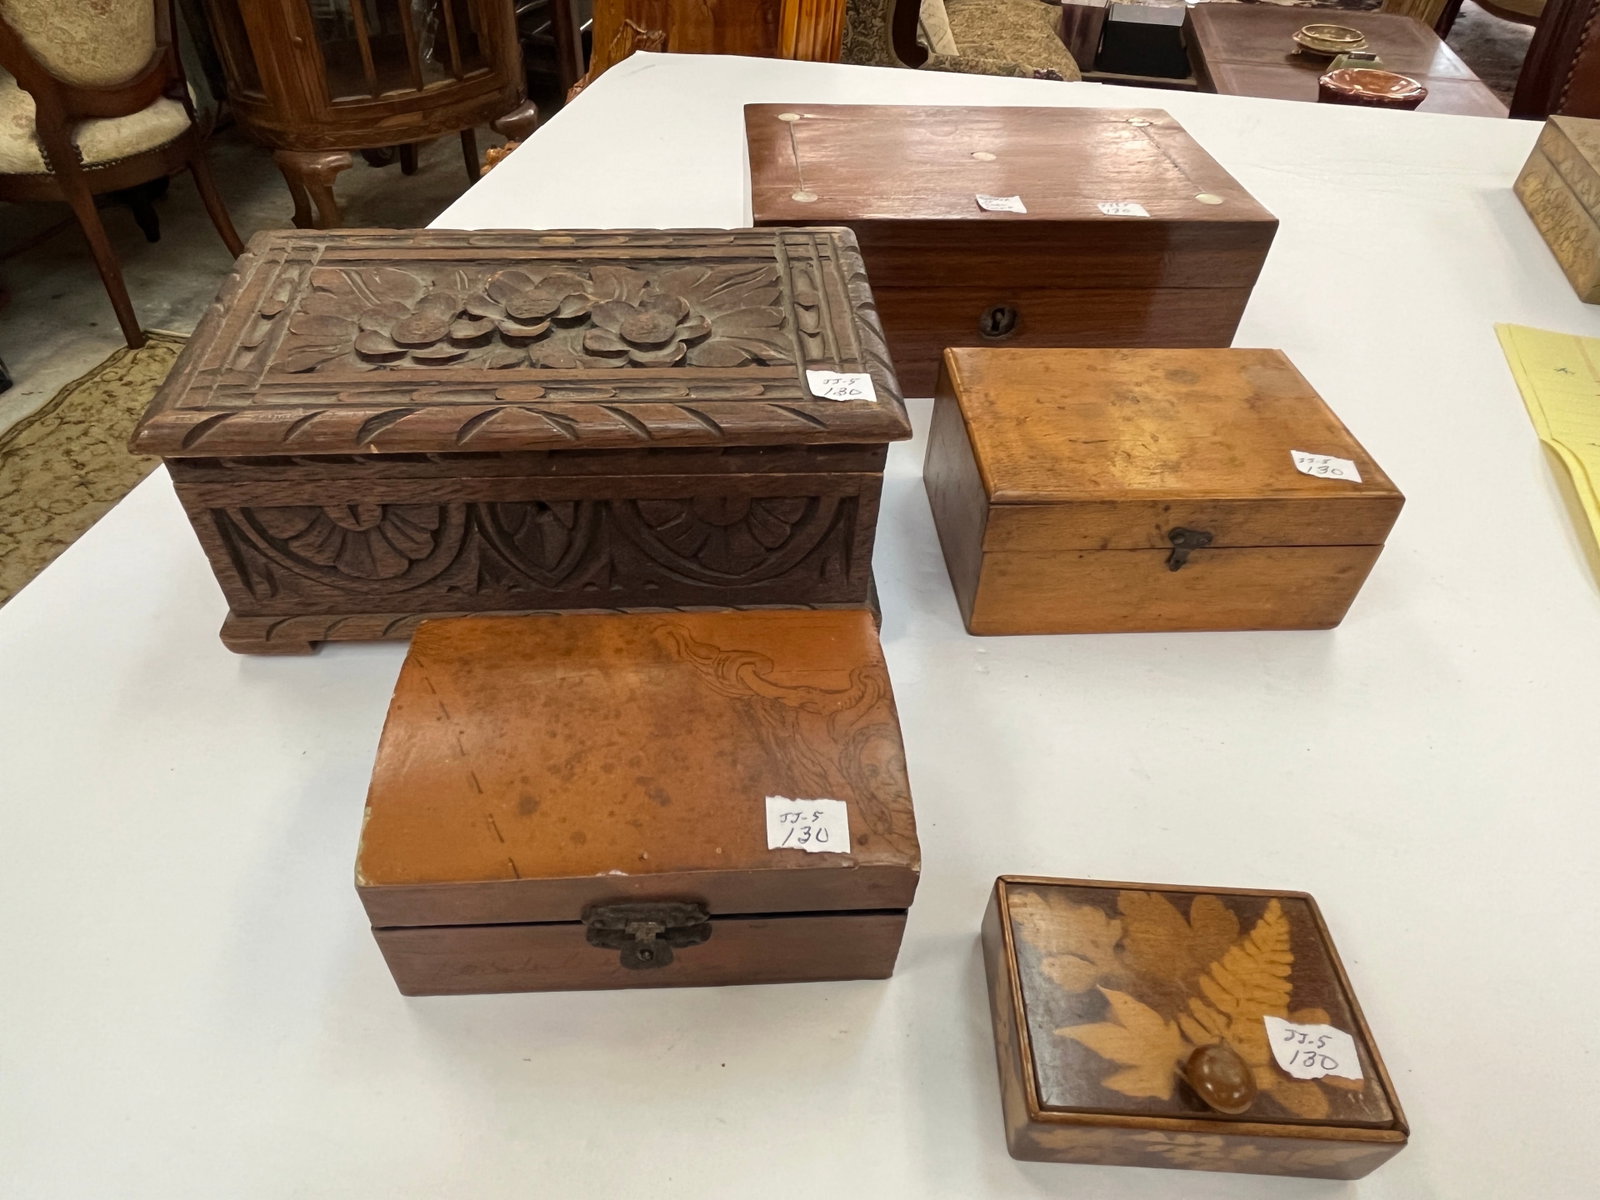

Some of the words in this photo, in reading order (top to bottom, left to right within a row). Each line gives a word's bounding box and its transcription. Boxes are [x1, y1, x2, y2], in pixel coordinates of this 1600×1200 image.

[1307, 465, 1344, 476] 130
[782, 826, 829, 846] 130
[1289, 1049, 1339, 1071] 130
